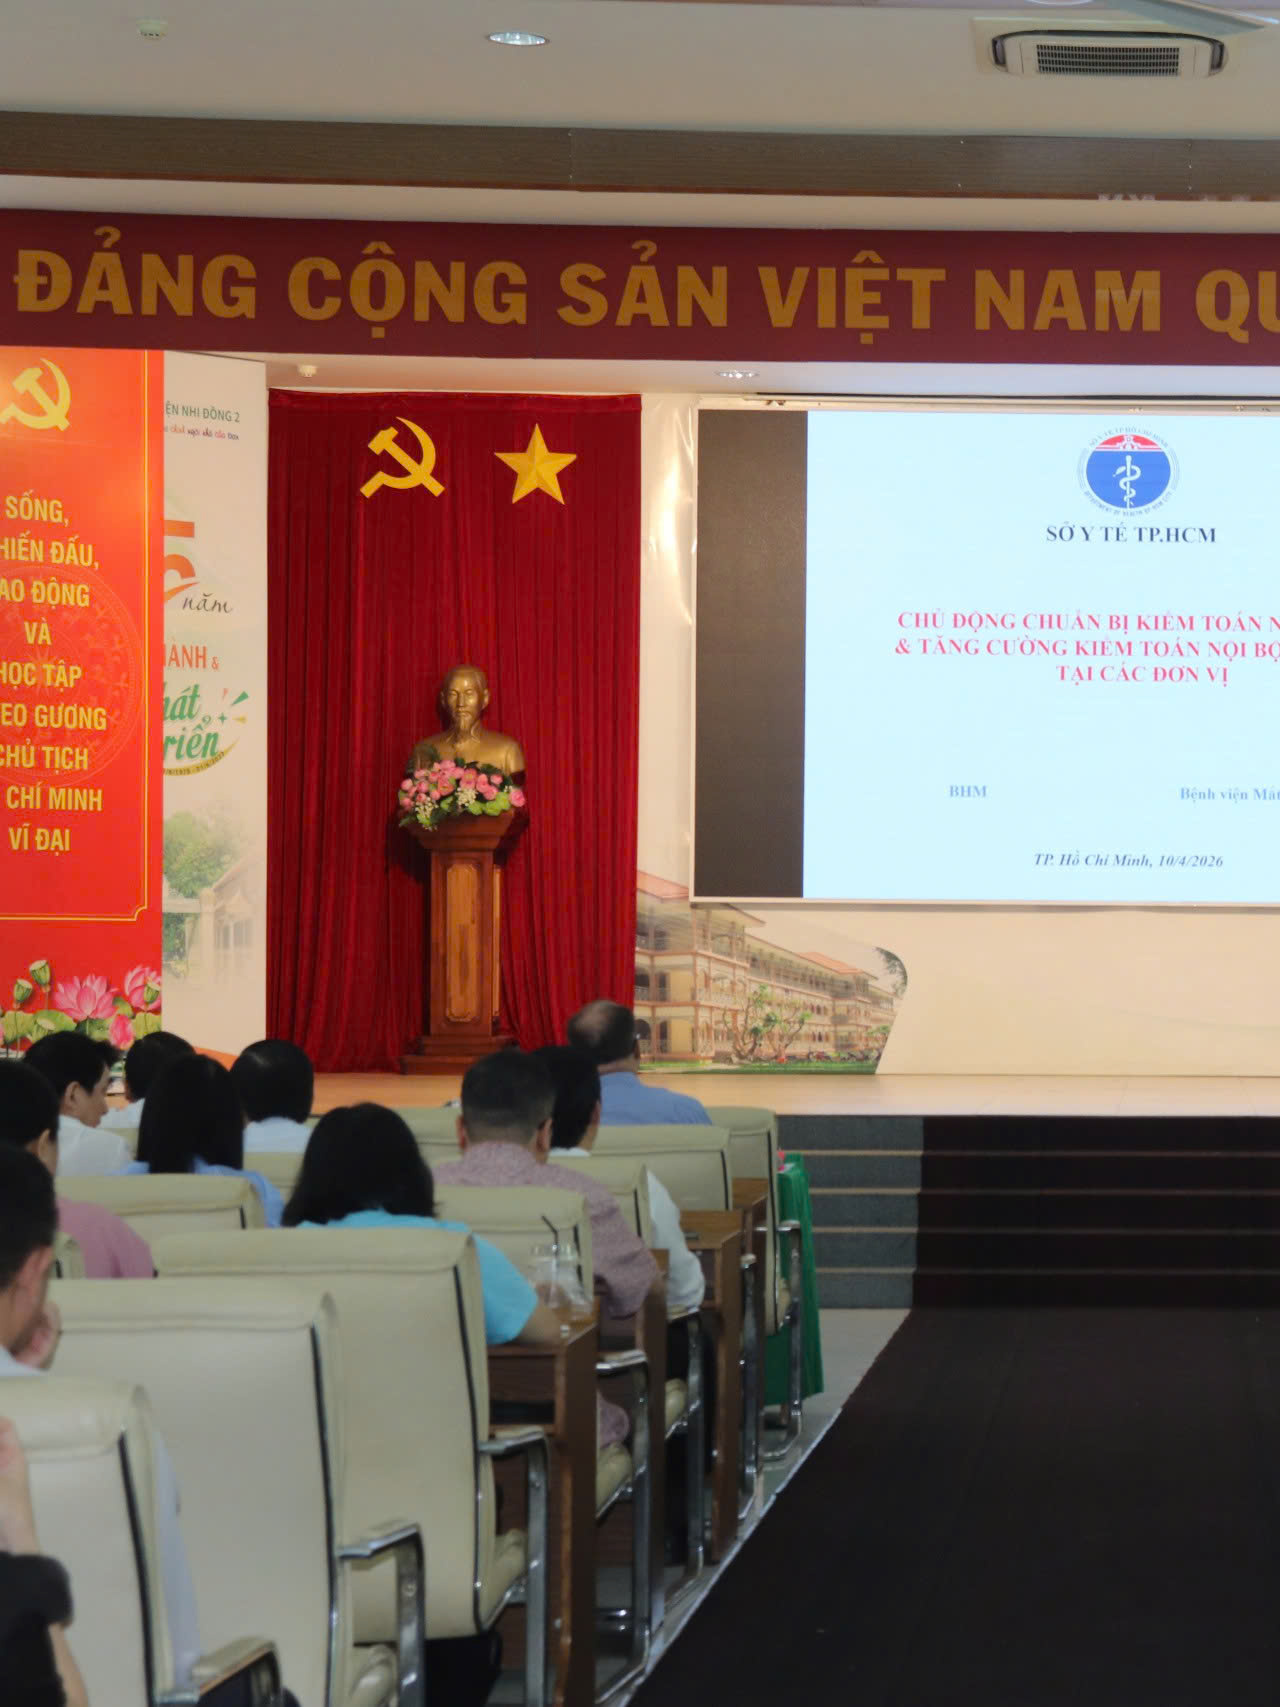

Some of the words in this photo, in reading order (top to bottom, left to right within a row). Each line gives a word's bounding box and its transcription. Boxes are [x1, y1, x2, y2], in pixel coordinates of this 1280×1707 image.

[13, 226, 257, 319] ĐẢNG
[288, 241, 528, 338] CỘNG
[556, 239, 727, 327] SẢN
[758, 250, 946, 344] VIỆT
[974, 270, 1161, 331] NAM
[182, 405, 200, 418] NHI
[235, 411, 240, 423] 2
[5, 489, 69, 527] SỐNG,
[1046, 521, 1076, 542] SỞ
[1080, 526, 1097, 542] Y
[1099, 522, 1128, 542] TẾ
[1134, 526, 1216, 544] TP.HCM
[50, 535, 99, 570] ĐẤU,
[31, 577, 90, 609] ĐỘNG
[183, 593, 233, 613] năm
[24, 617, 52, 646] VÀ
[897, 608, 945, 629] CHỦ
[952, 611, 1016, 633] ĐỘNG
[1022, 609, 1101, 631] CHUẨN
[1108, 614, 1129, 635] BỊ
[1136, 610, 1195, 631] KIỂM
[1201, 610, 1262, 632] TOÁN
[895, 638, 912, 655] &
[918, 635, 979, 655] TĂNG
[986, 634, 1068, 656] CƯỜNG
[1075, 636, 1133, 657] KIỂM
[1141, 637, 1200, 657] TOÁN
[1206, 640, 1246, 662] NỘI
[41, 659, 83, 692] TẬP
[211, 656, 220, 671] &
[1055, 665, 1093, 686] TẠI
[1100, 661, 1146, 682] CÁC
[1152, 666, 1199, 682] ĐƠN
[1205, 667, 1228, 688] VỊ
[34, 703, 107, 730] GƯƠNG
[41, 746, 89, 774] TỊCH
[6, 782, 41, 810] CHÍ
[48, 787, 103, 811] MINH
[949, 785, 987, 798] BHM
[1180, 786, 1215, 804] Bệnh
[1220, 786, 1248, 804] viện
[8, 823, 29, 850] VĨ
[35, 828, 71, 857] ĐẠI
[1034, 853, 1054, 867] TP.
[1059, 850, 1080, 866] Hồ
[1084, 853, 1108, 866] Chí
[1112, 854, 1153, 868] Minh,
[1159, 854, 1224, 867] 10/4/2026
